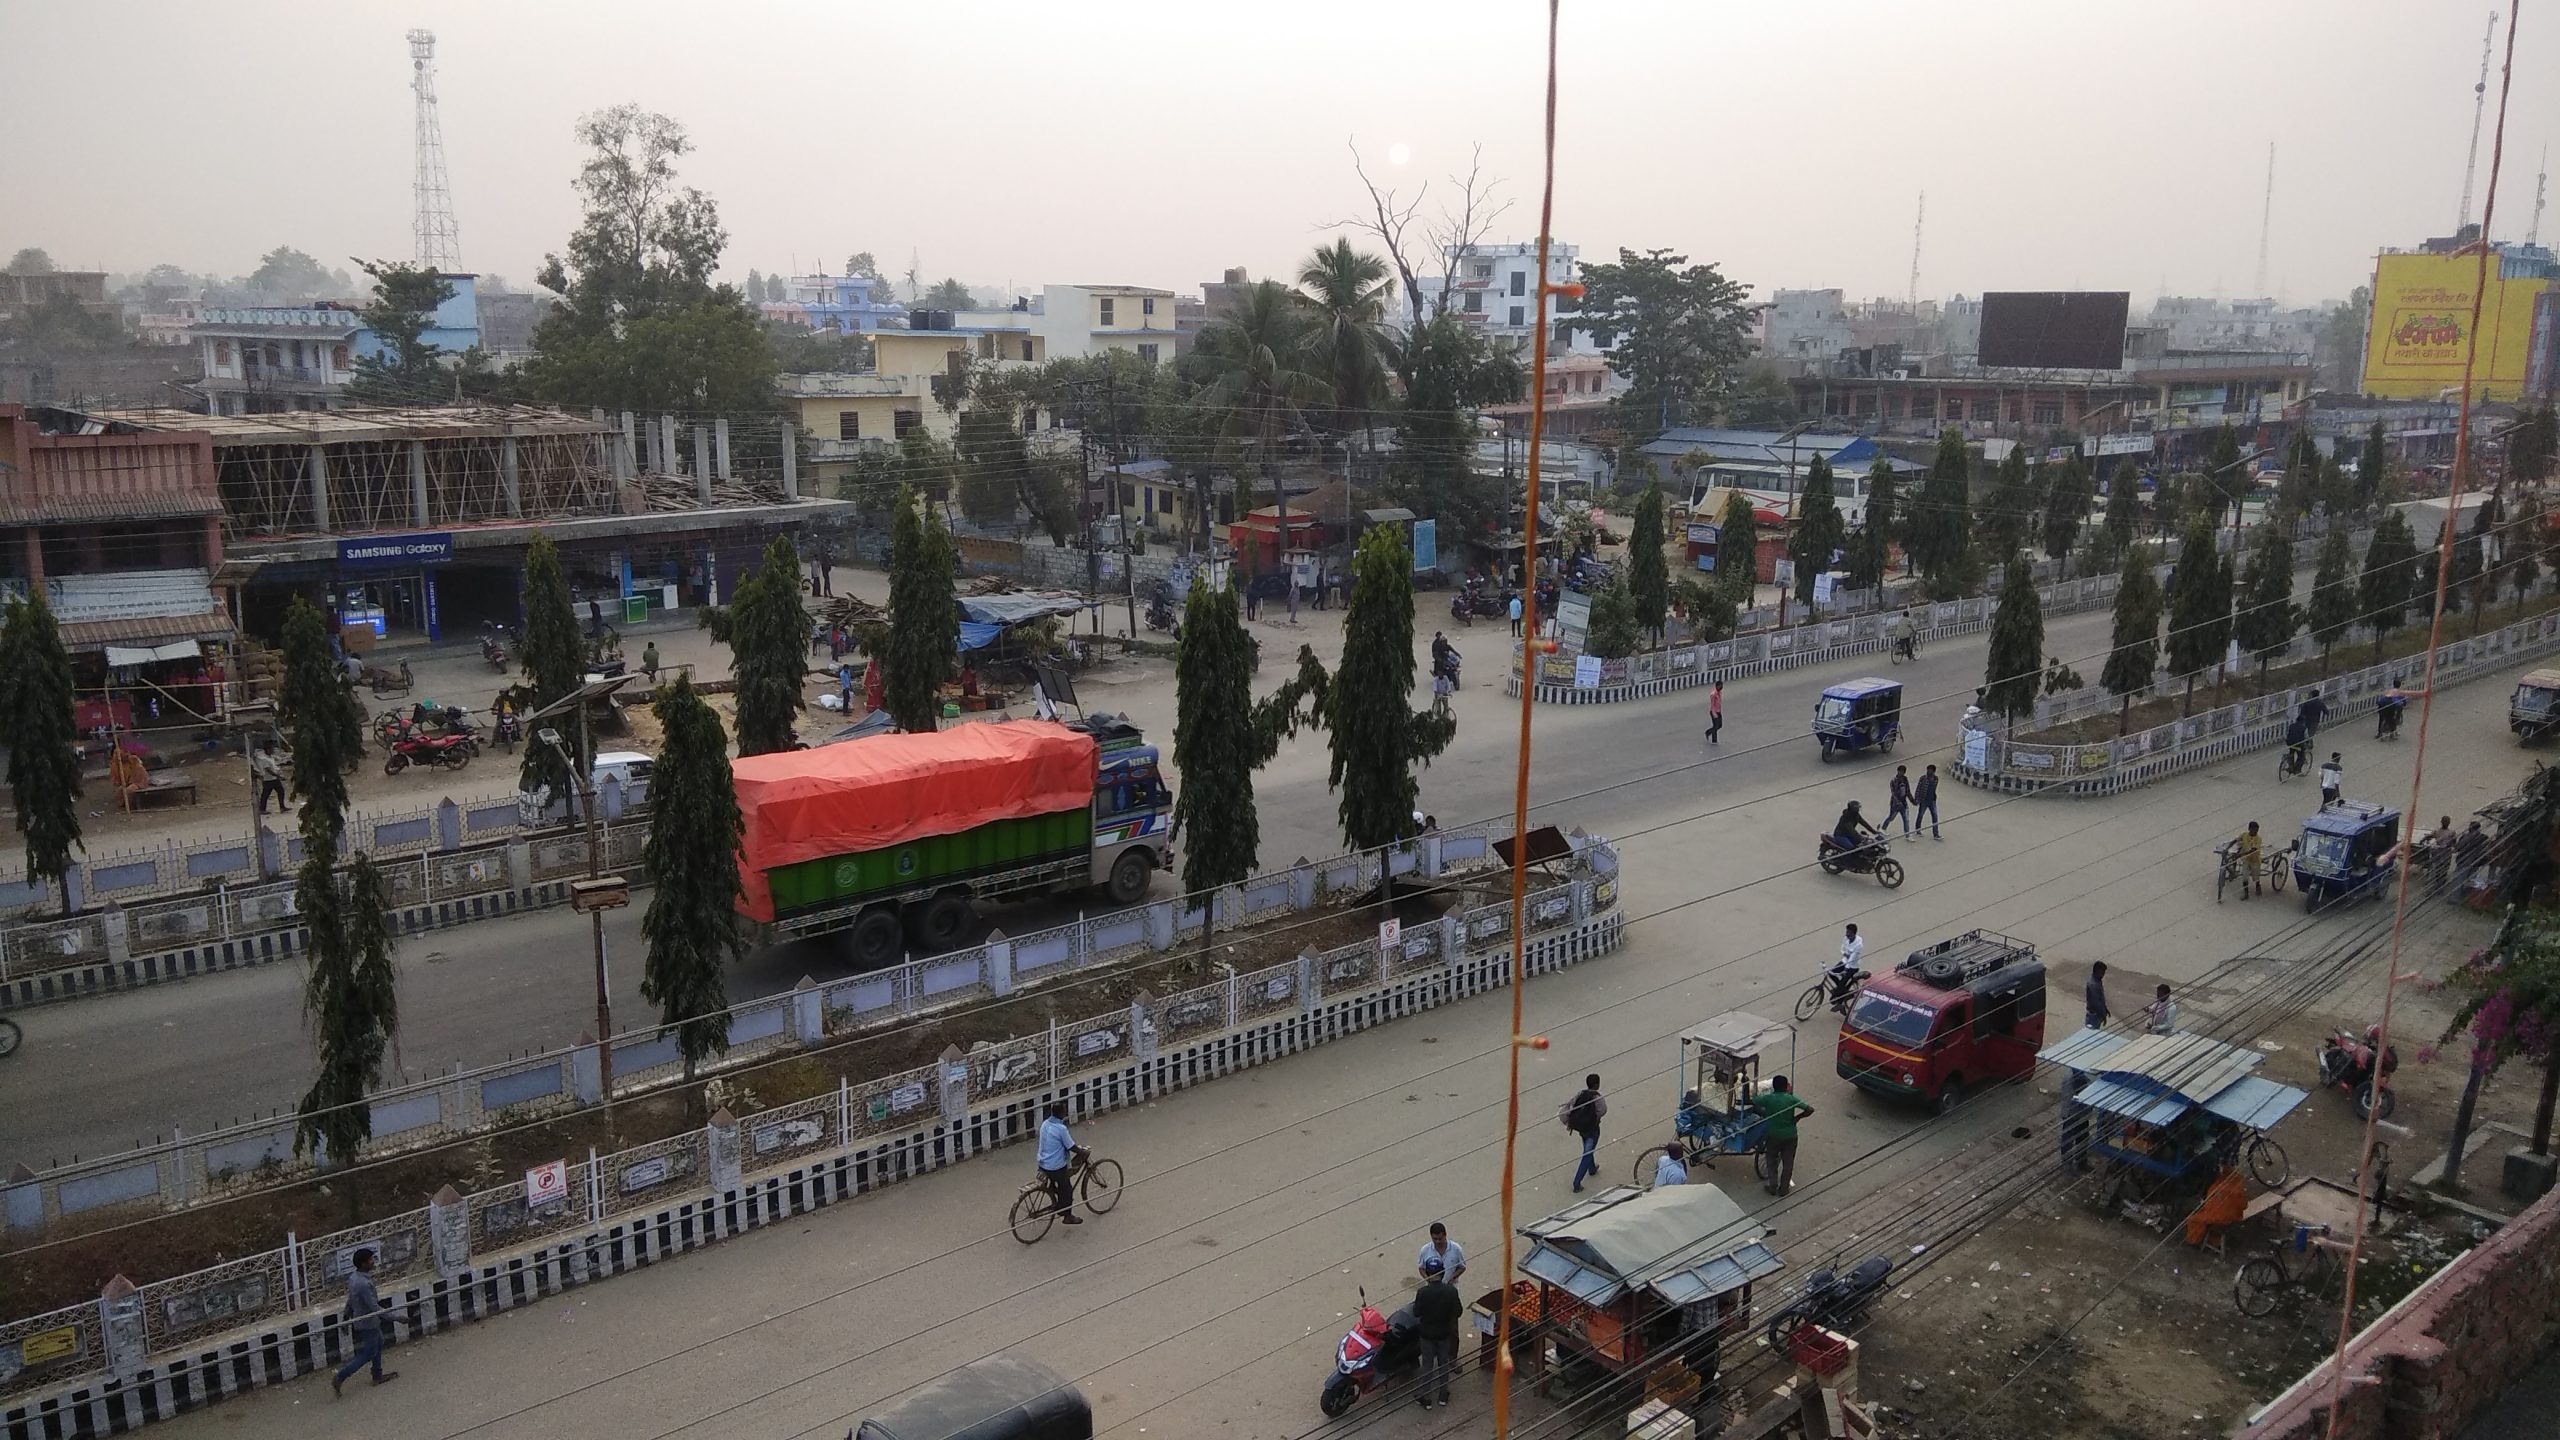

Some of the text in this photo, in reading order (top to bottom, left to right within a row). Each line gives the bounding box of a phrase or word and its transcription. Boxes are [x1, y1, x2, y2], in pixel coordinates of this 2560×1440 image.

[346, 543, 446, 559] SAMSUNG Galaxy
[1128, 755, 1151, 768] NIKE
